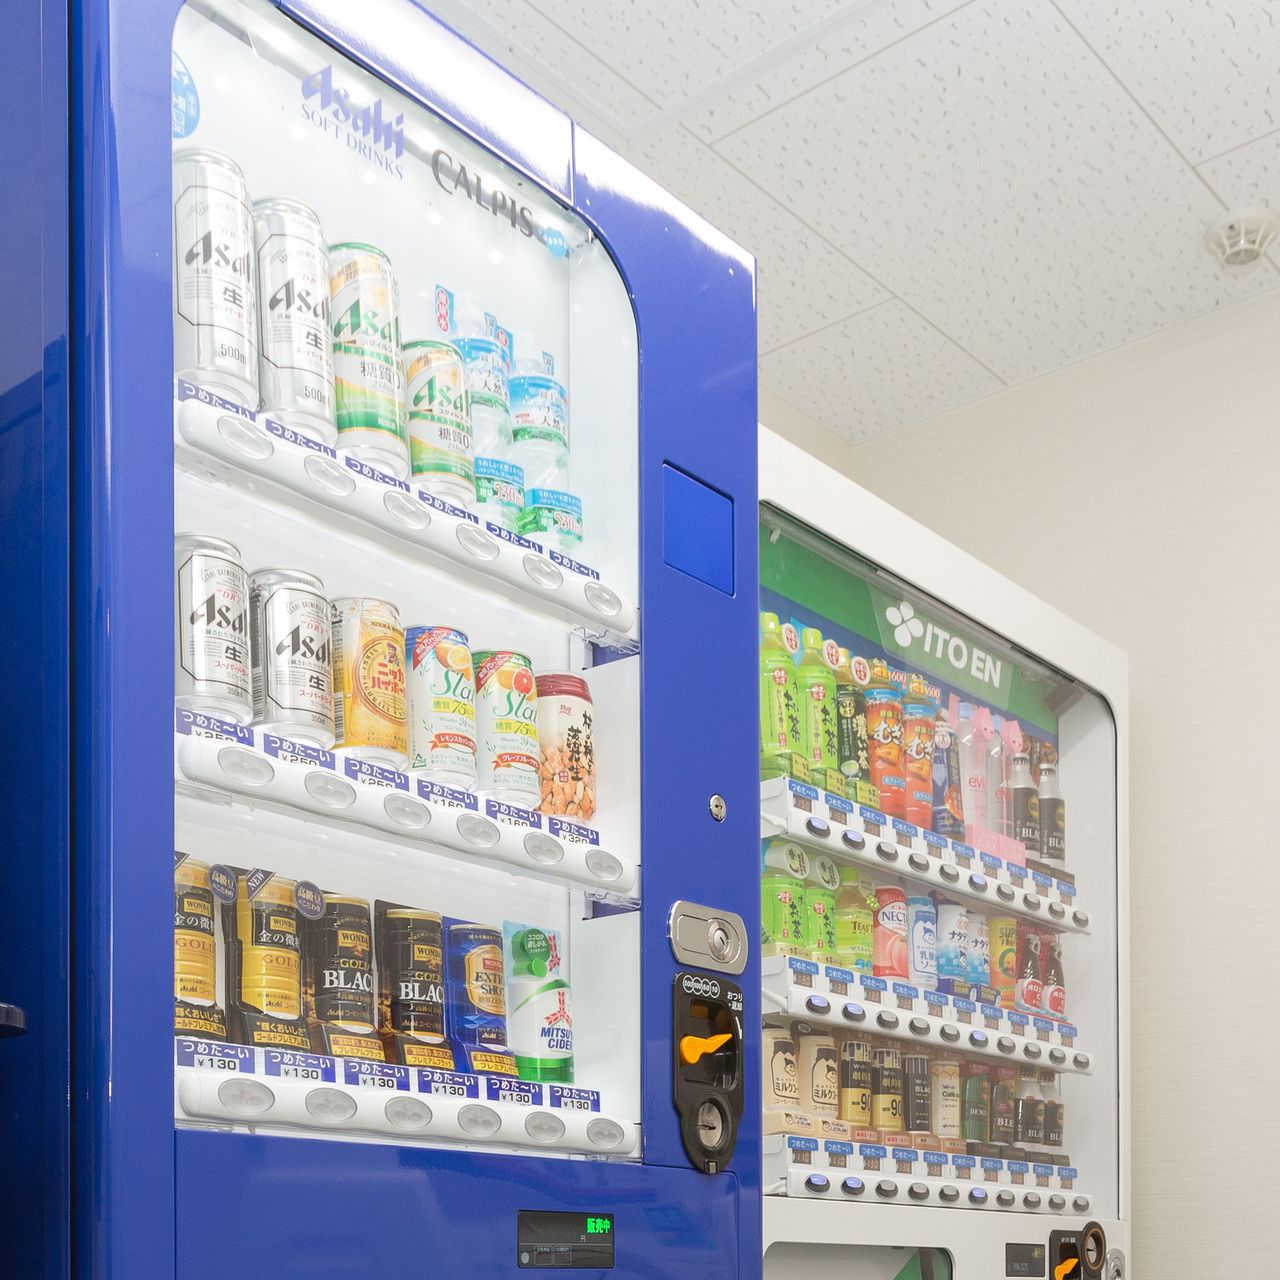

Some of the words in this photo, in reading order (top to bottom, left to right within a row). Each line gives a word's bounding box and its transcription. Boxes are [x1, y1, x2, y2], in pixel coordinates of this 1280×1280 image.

[301, 65, 405, 159] Asahi
[301, 104, 341, 141] SOFT
[346, 133, 404, 181] DRINKS
[431, 148, 535, 239] CALPIS
[223, 287, 244, 309] 生
[306, 331, 324, 351] 生
[224, 645, 243, 665] 生
[923, 621, 968, 670] ITO
[971, 646, 1002, 689] EN
[308, 675, 326, 693] 生
[183, 710, 249, 738] つめた～い
[269, 736, 332, 763] つめた～い
[349, 761, 406, 785] つめた～い
[422, 781, 478, 805] つめた～い
[489, 800, 539, 823] つめた～い
[552, 819, 597, 840] つめた～い
[247, 870, 265, 890] NEW
[323, 970, 373, 992] BLAC
[399, 982, 444, 1005] BLAC
[727, 990, 743, 1002] おつり
[540, 1026, 573, 1039] MITSU
[182, 1041, 250, 1059] つめた～い
[270, 1051, 331, 1068] つめた～い
[197, 1057, 237, 1071] ¥130
[284, 1067, 319, 1080] ¥130
[349, 1061, 405, 1078] つめた～い
[361, 1077, 395, 1089] ¥130
[422, 1071, 475, 1086] つめた～い
[490, 1079, 539, 1094] つめた～い
[434, 1085, 465, 1097] ¥130
[501, 1092, 530, 1104] ¥130
[553, 1087, 598, 1100] つめた～い
[563, 1099, 590, 1110] ¥130
[586, 1217, 611, 1234] 販売中
